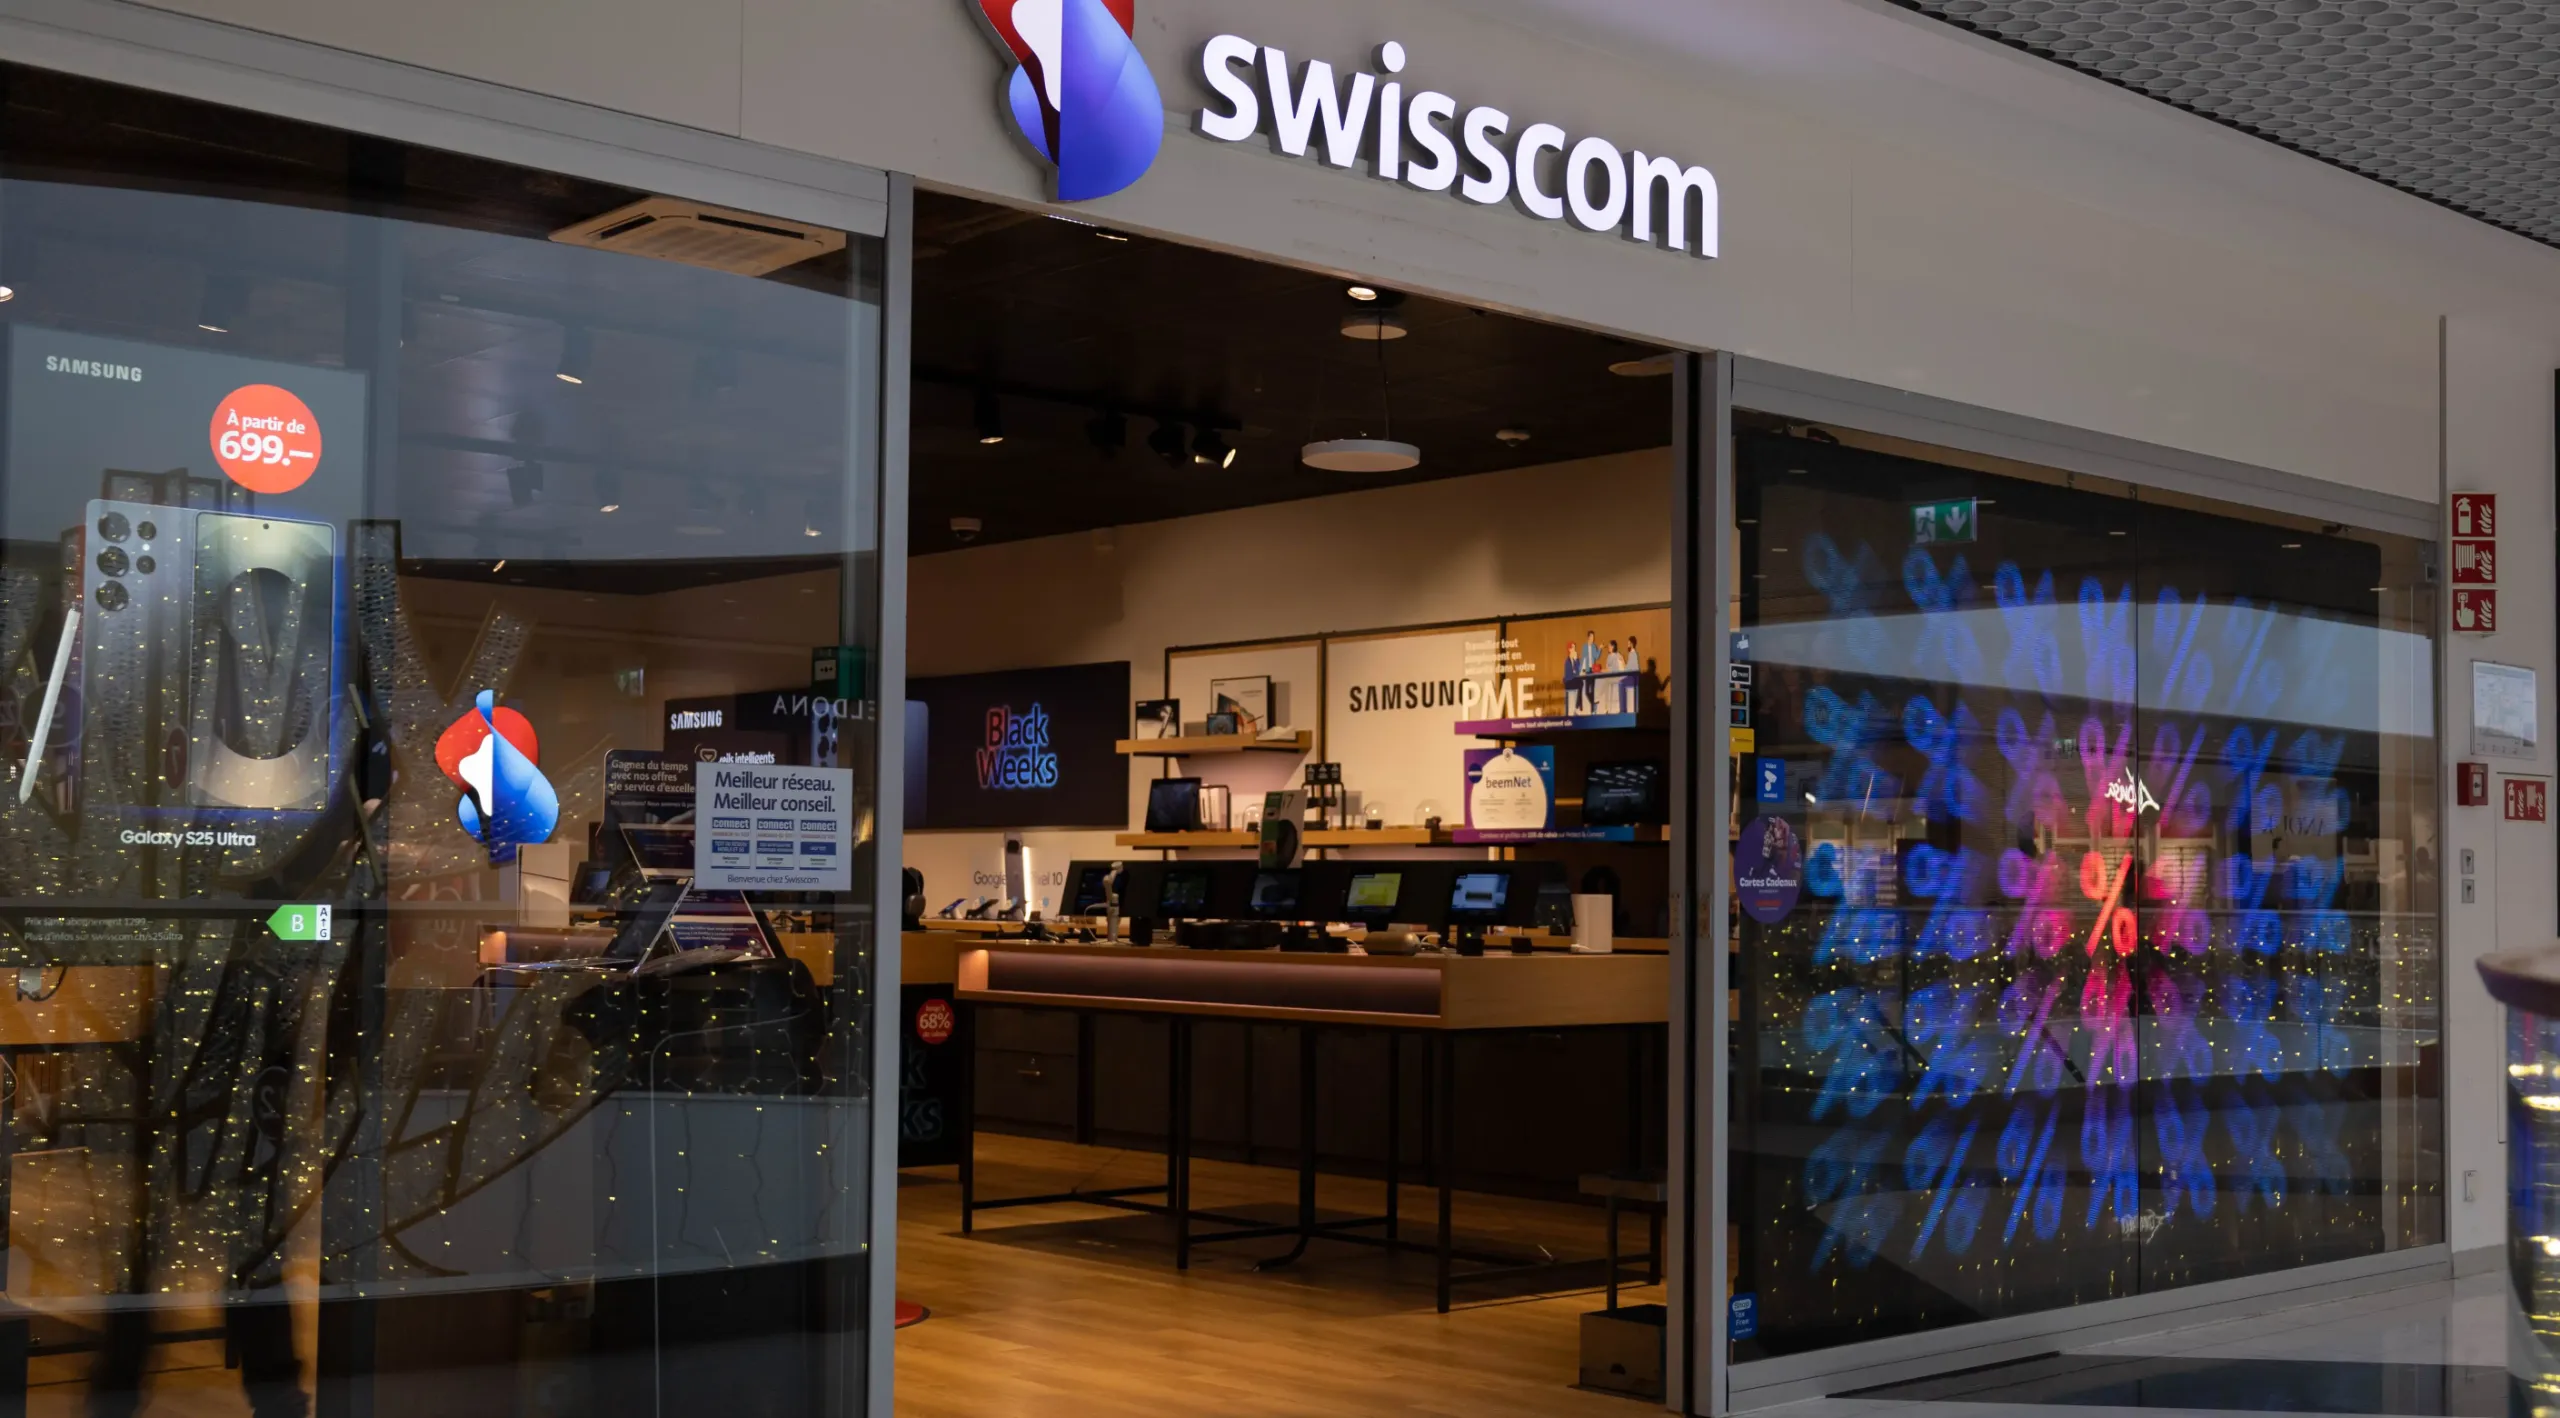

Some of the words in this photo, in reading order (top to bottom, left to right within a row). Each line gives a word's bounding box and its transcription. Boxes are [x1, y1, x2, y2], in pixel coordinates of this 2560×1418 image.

[1199, 34, 1720, 259] swisscom
[46, 354, 143, 383] SAMSUNG
[226, 408, 240, 427] À
[242, 413, 284, 434] partir
[286, 418, 306, 436] de
[1462, 677, 1543, 721] PME.
[670, 710, 723, 730] SAMSUNG
[986, 703, 1050, 748] Black
[611, 760, 645, 771] Gagnez
[647, 760, 659, 769] du
[661, 761, 689, 773] temps
[976, 746, 1059, 790] Weeks
[611, 772, 632, 780] avec
[634, 773, 650, 781] nos
[651, 772, 677, 781] offres
[715, 771, 778, 789] Meilleur
[782, 773, 836, 792] réseau.
[1485, 776, 1532, 789] beemNet
[610, 782, 622, 791] de
[624, 783, 655, 792] service
[714, 792, 777, 811] Meilleur
[781, 795, 836, 813] conseil.
[713, 819, 750, 829] connect
[758, 820, 793, 830] connect
[801, 822, 836, 832] connect
[120, 829, 183, 848] Galaxy
[185, 831, 214, 846] S25
[217, 831, 256, 847] Ultra
[727, 875, 765, 883] Bienvenue
[767, 875, 783, 883] chez
[785, 876, 819, 884] Swisscom
[973, 871, 1006, 888] Google
[1052, 871, 1063, 885] 10
[1739, 876, 1765, 888] Cartes
[1766, 876, 1797, 888] Cadeaux
[290, 913, 304, 933] B
[919, 1012, 950, 1029] 68%
